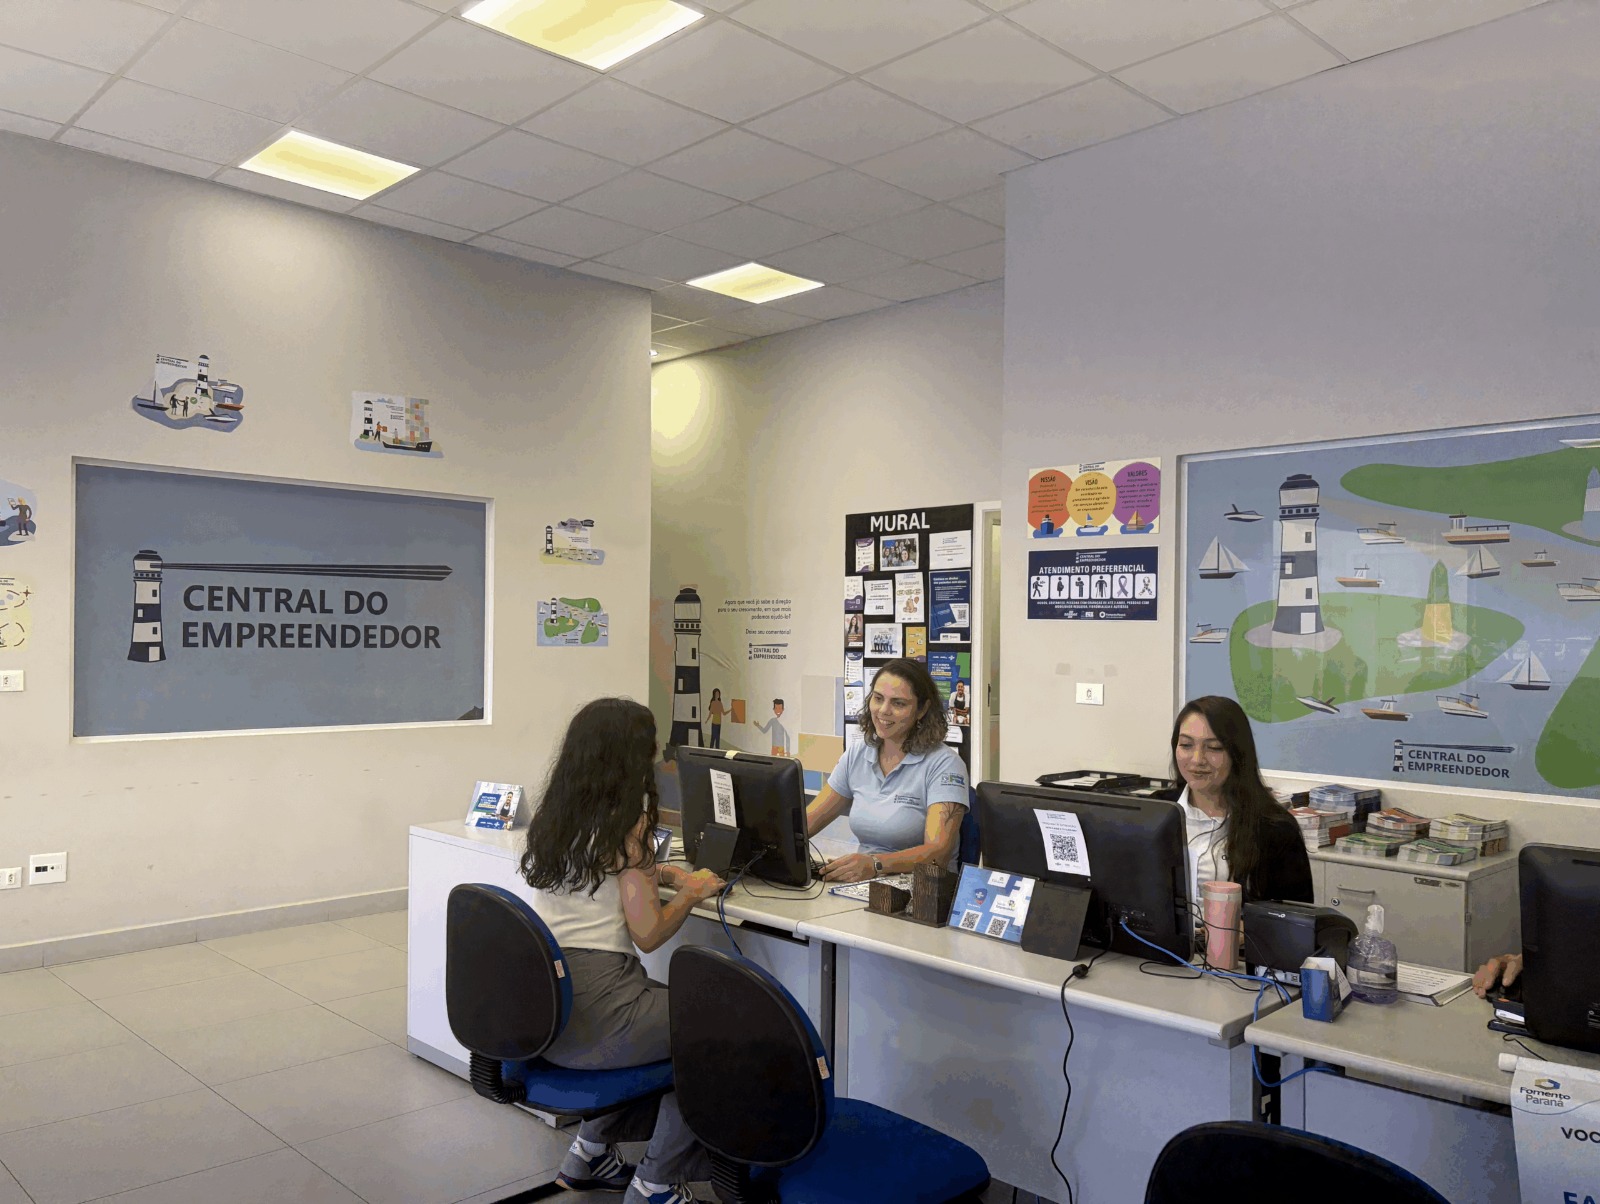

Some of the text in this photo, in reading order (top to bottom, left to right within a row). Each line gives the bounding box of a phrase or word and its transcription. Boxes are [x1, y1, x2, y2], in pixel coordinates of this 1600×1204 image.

[870, 512, 930, 532] MURAL
[1039, 564, 1145, 574] ATENDIMENTO PREFERENCIAL
[183, 584, 388, 616] CENTRAL DO
[182, 621, 441, 649] EMPREENDEDOR
[1408, 750, 1486, 764] CENTRAL DO
[1408, 762, 1510, 778] EMPREENDEDOR
[1520, 1087, 1571, 1100] Fomento
[1526, 1094, 1564, 1107] Paraná
